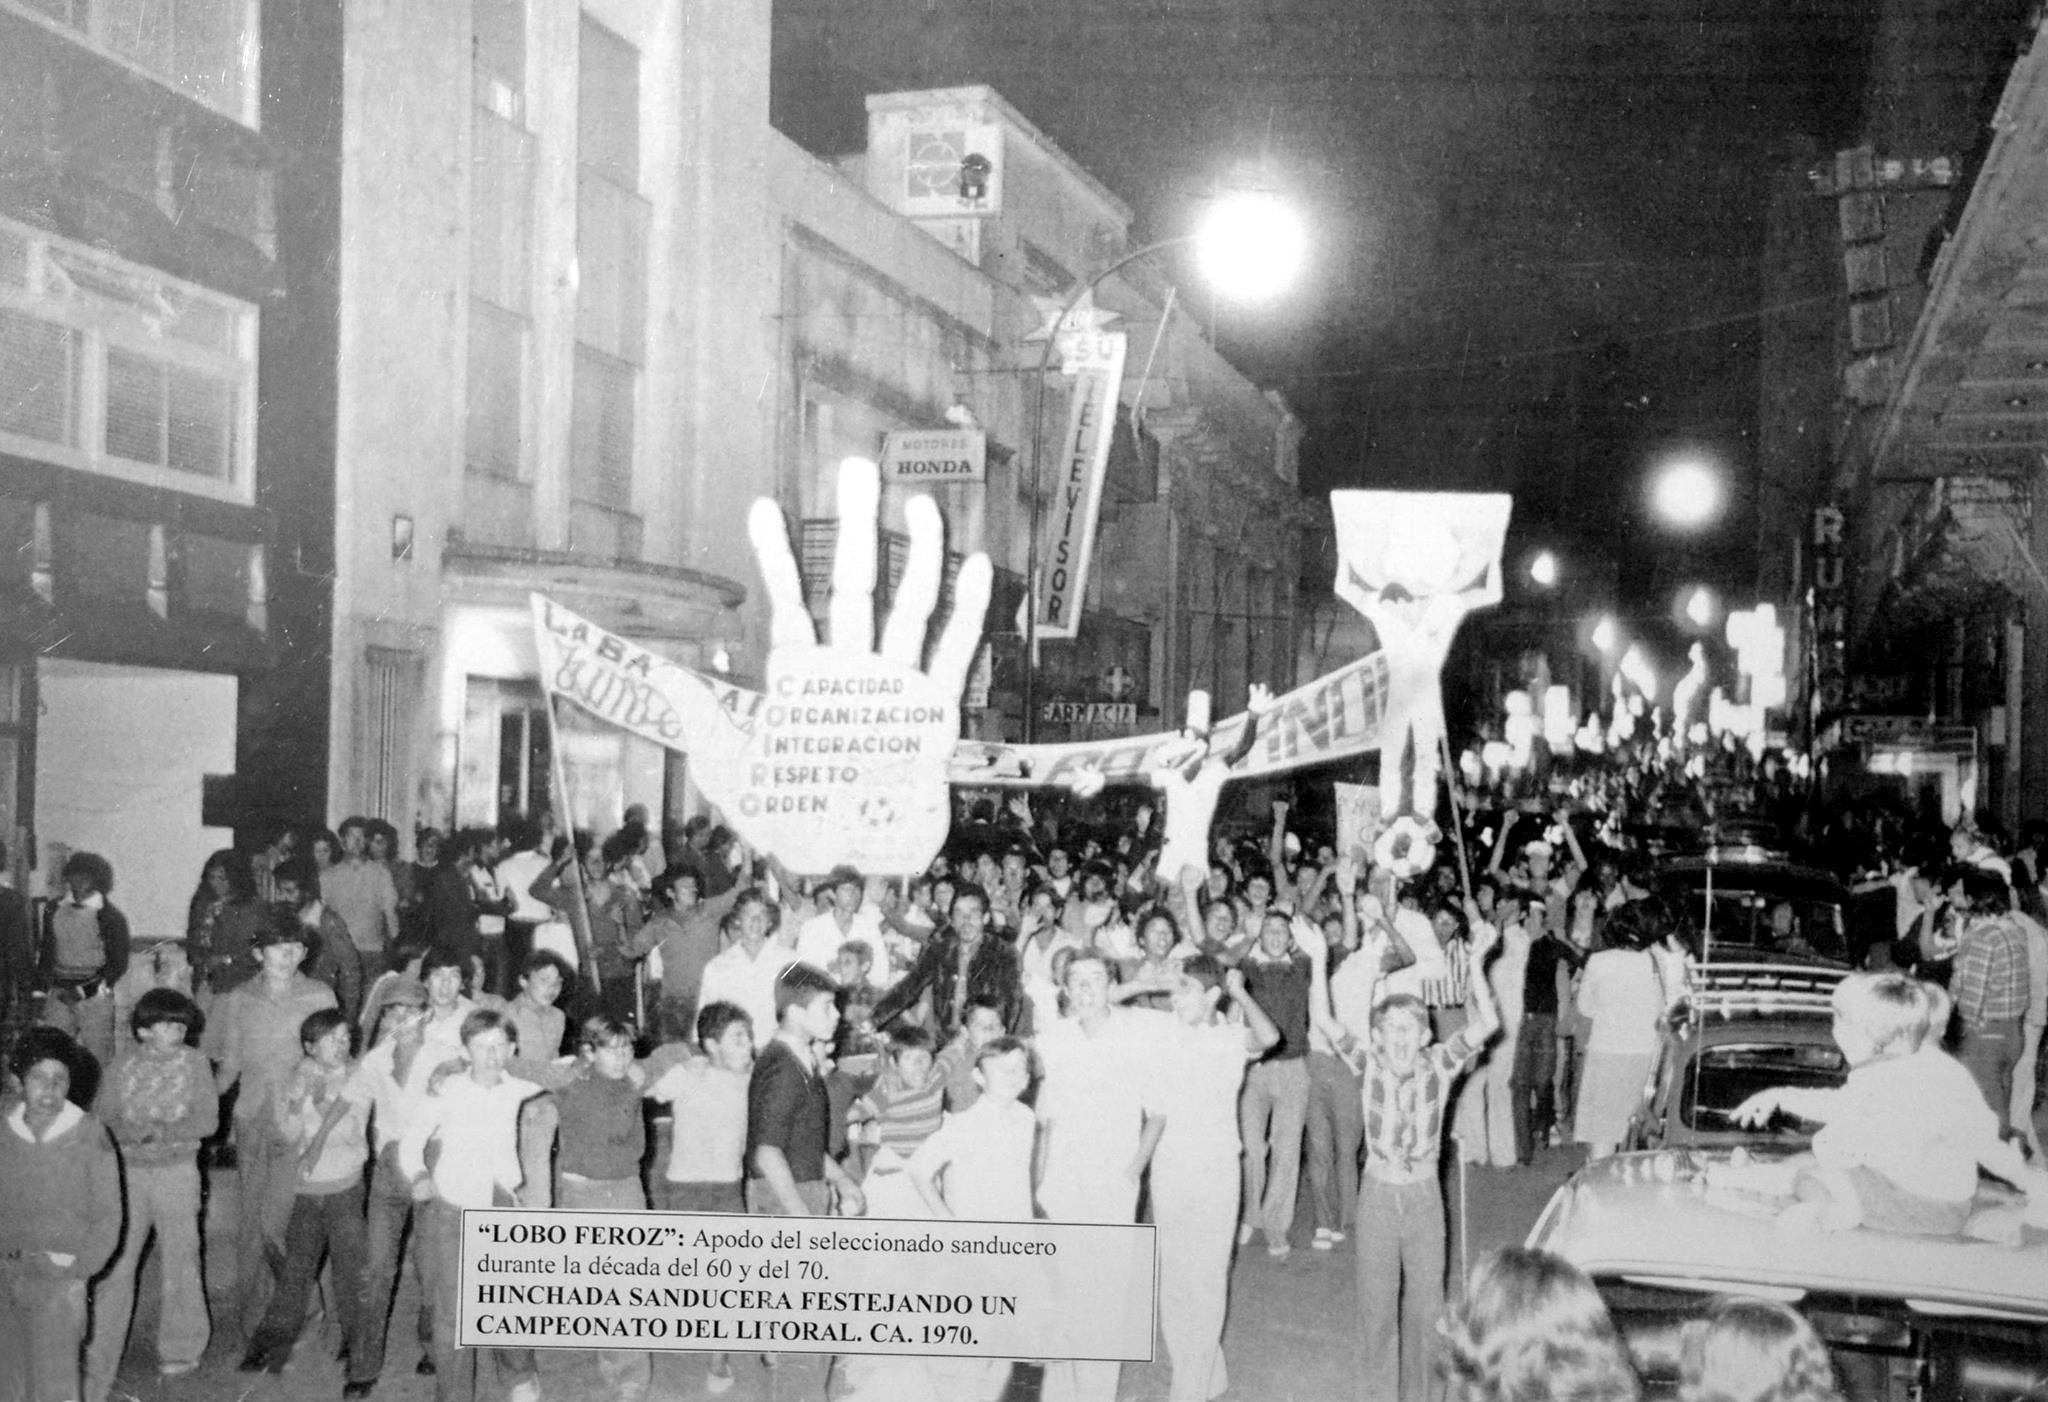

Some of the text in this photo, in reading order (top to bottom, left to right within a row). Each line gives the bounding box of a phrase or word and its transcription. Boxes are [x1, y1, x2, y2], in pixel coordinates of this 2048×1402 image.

[897, 460, 972, 474] HONDA
[1048, 378, 1098, 622] TELEVISOR
[776, 674, 904, 697] CAPACIDAD
[763, 733, 922, 757] INTEGRACION
[751, 762, 858, 787] RESPETO
[739, 793, 828, 817] ORDEN
